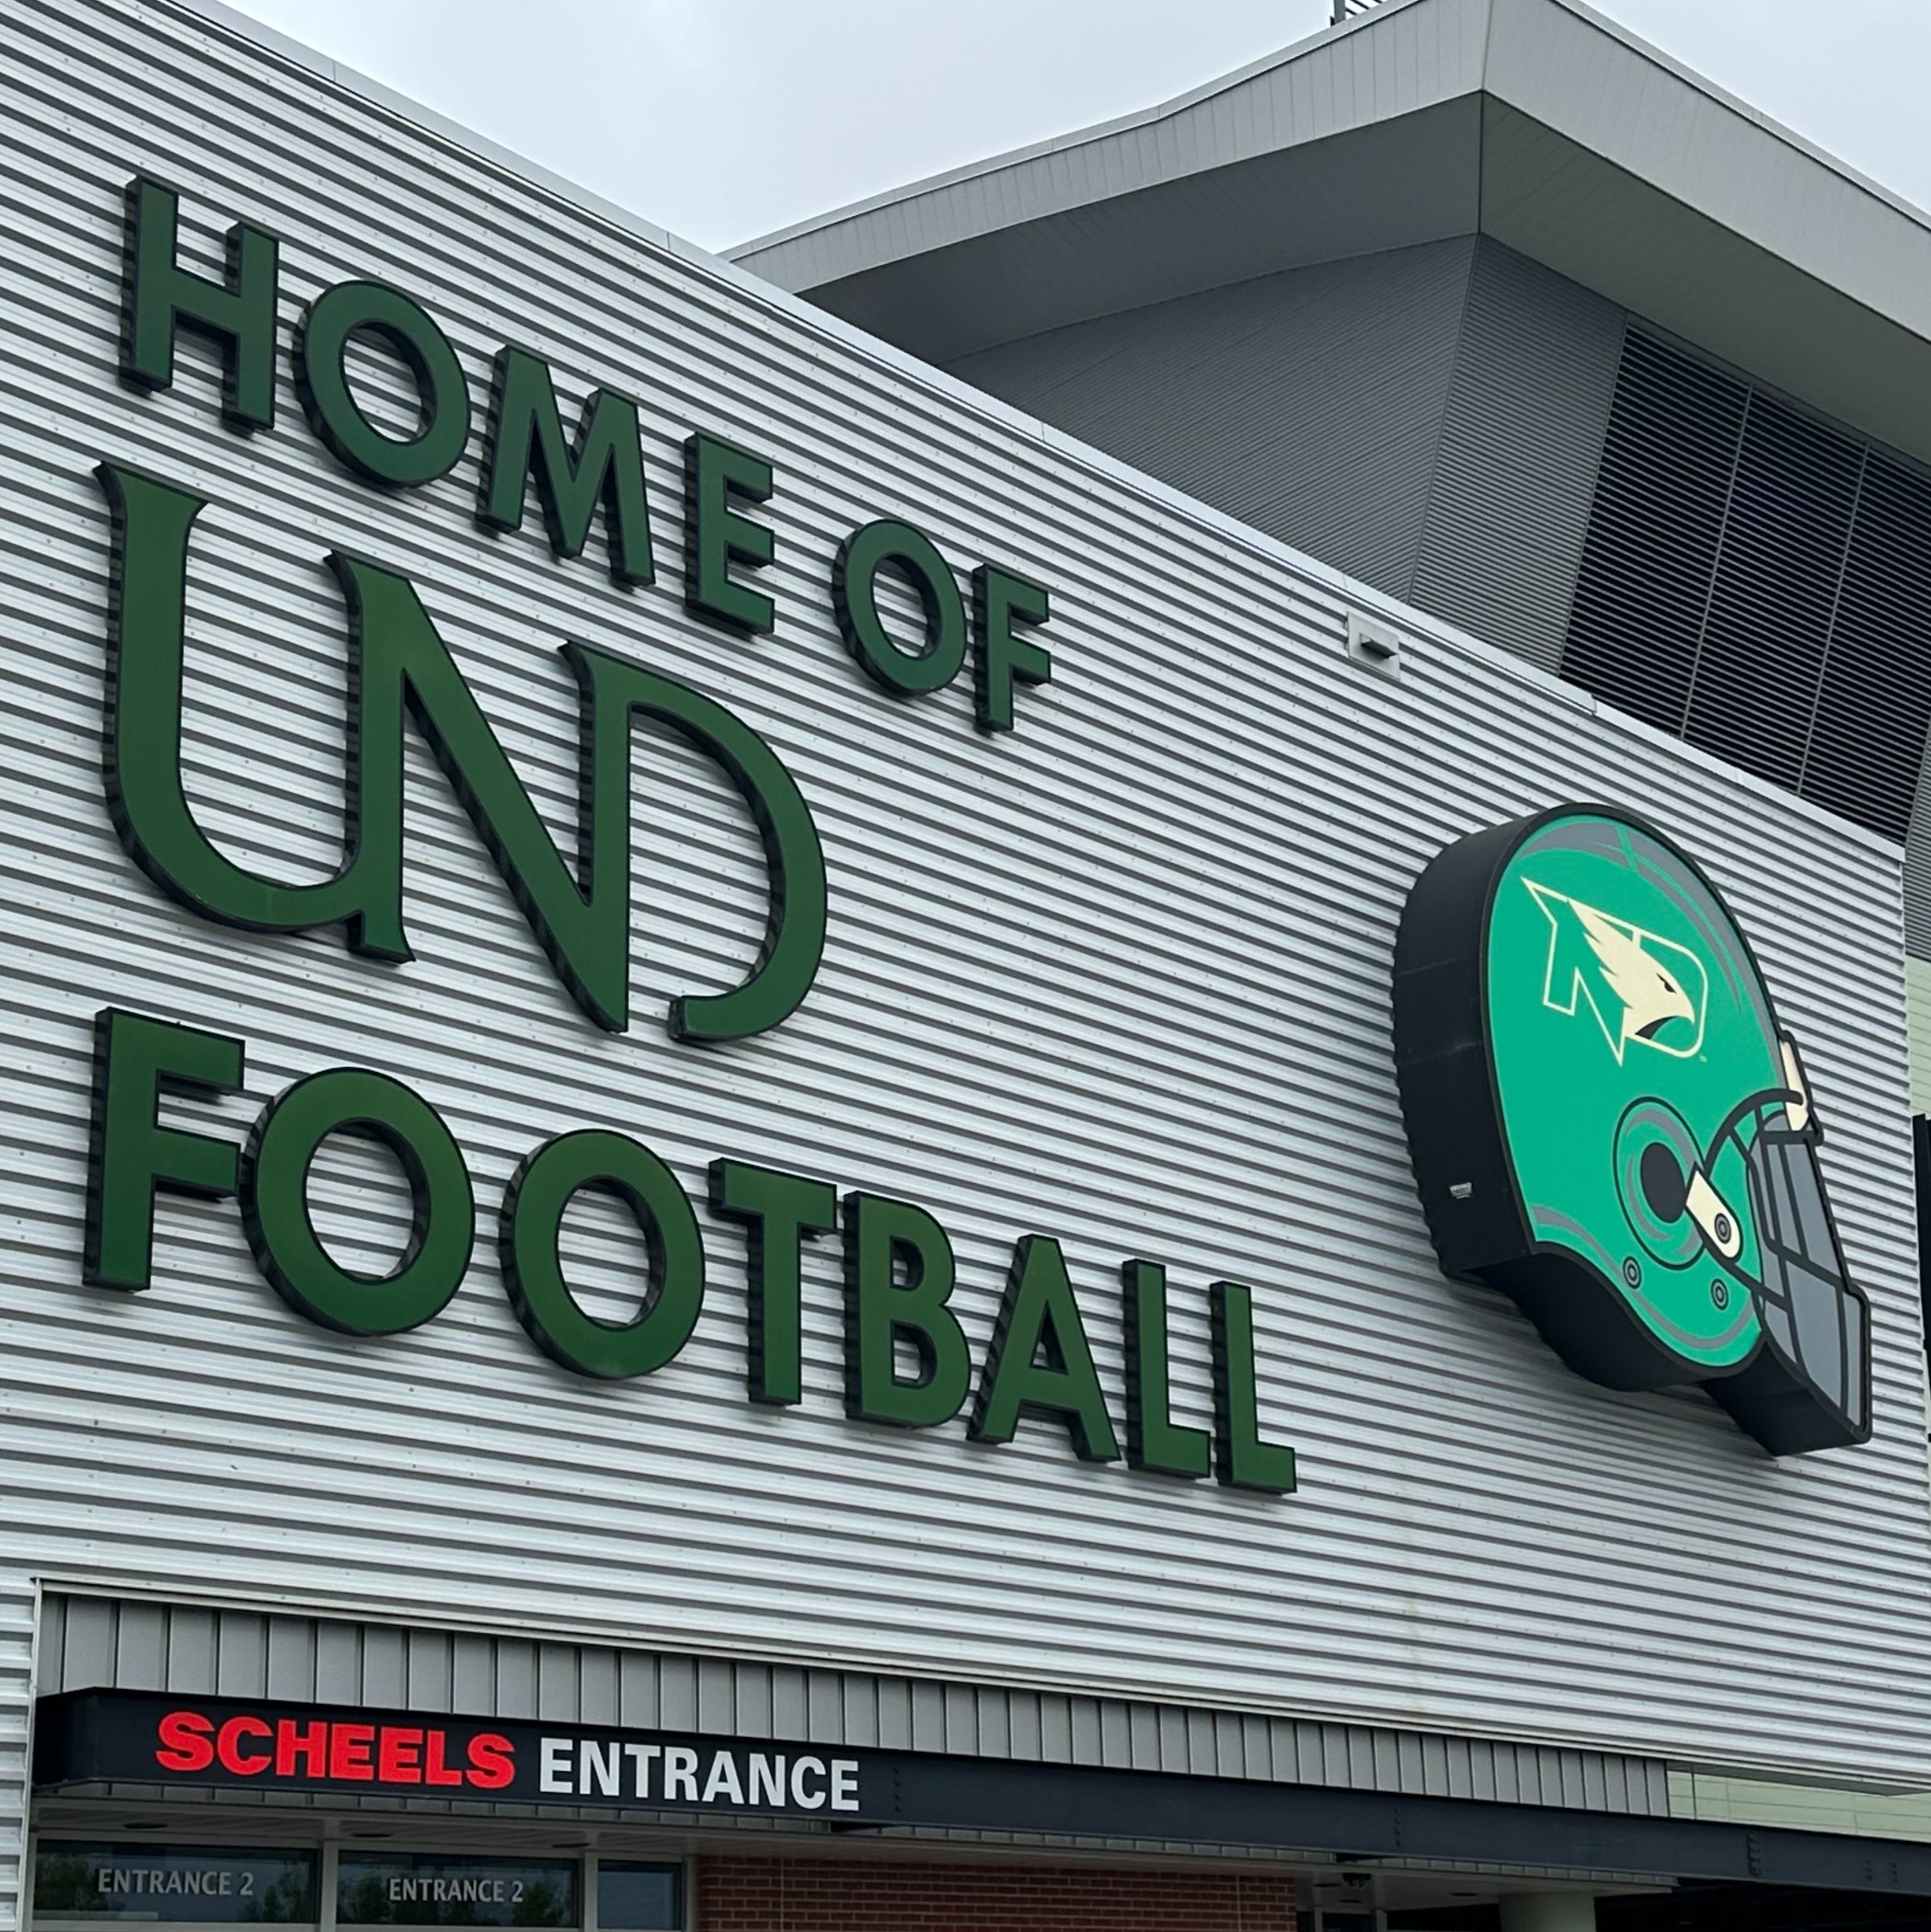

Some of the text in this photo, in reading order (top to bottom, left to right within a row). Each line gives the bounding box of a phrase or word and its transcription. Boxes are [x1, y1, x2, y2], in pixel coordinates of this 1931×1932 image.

[121, 175, 1051, 732] HOME OF
[93, 460, 828, 1042] UND
[83, 1007, 1297, 1494] FOOTBALL
[98, 1868, 255, 1896] ENTRANCE 2
[155, 1710, 860, 1812] SCHEELS ENTRANCE
[389, 1878, 523, 1903] ENTRANCE 2
